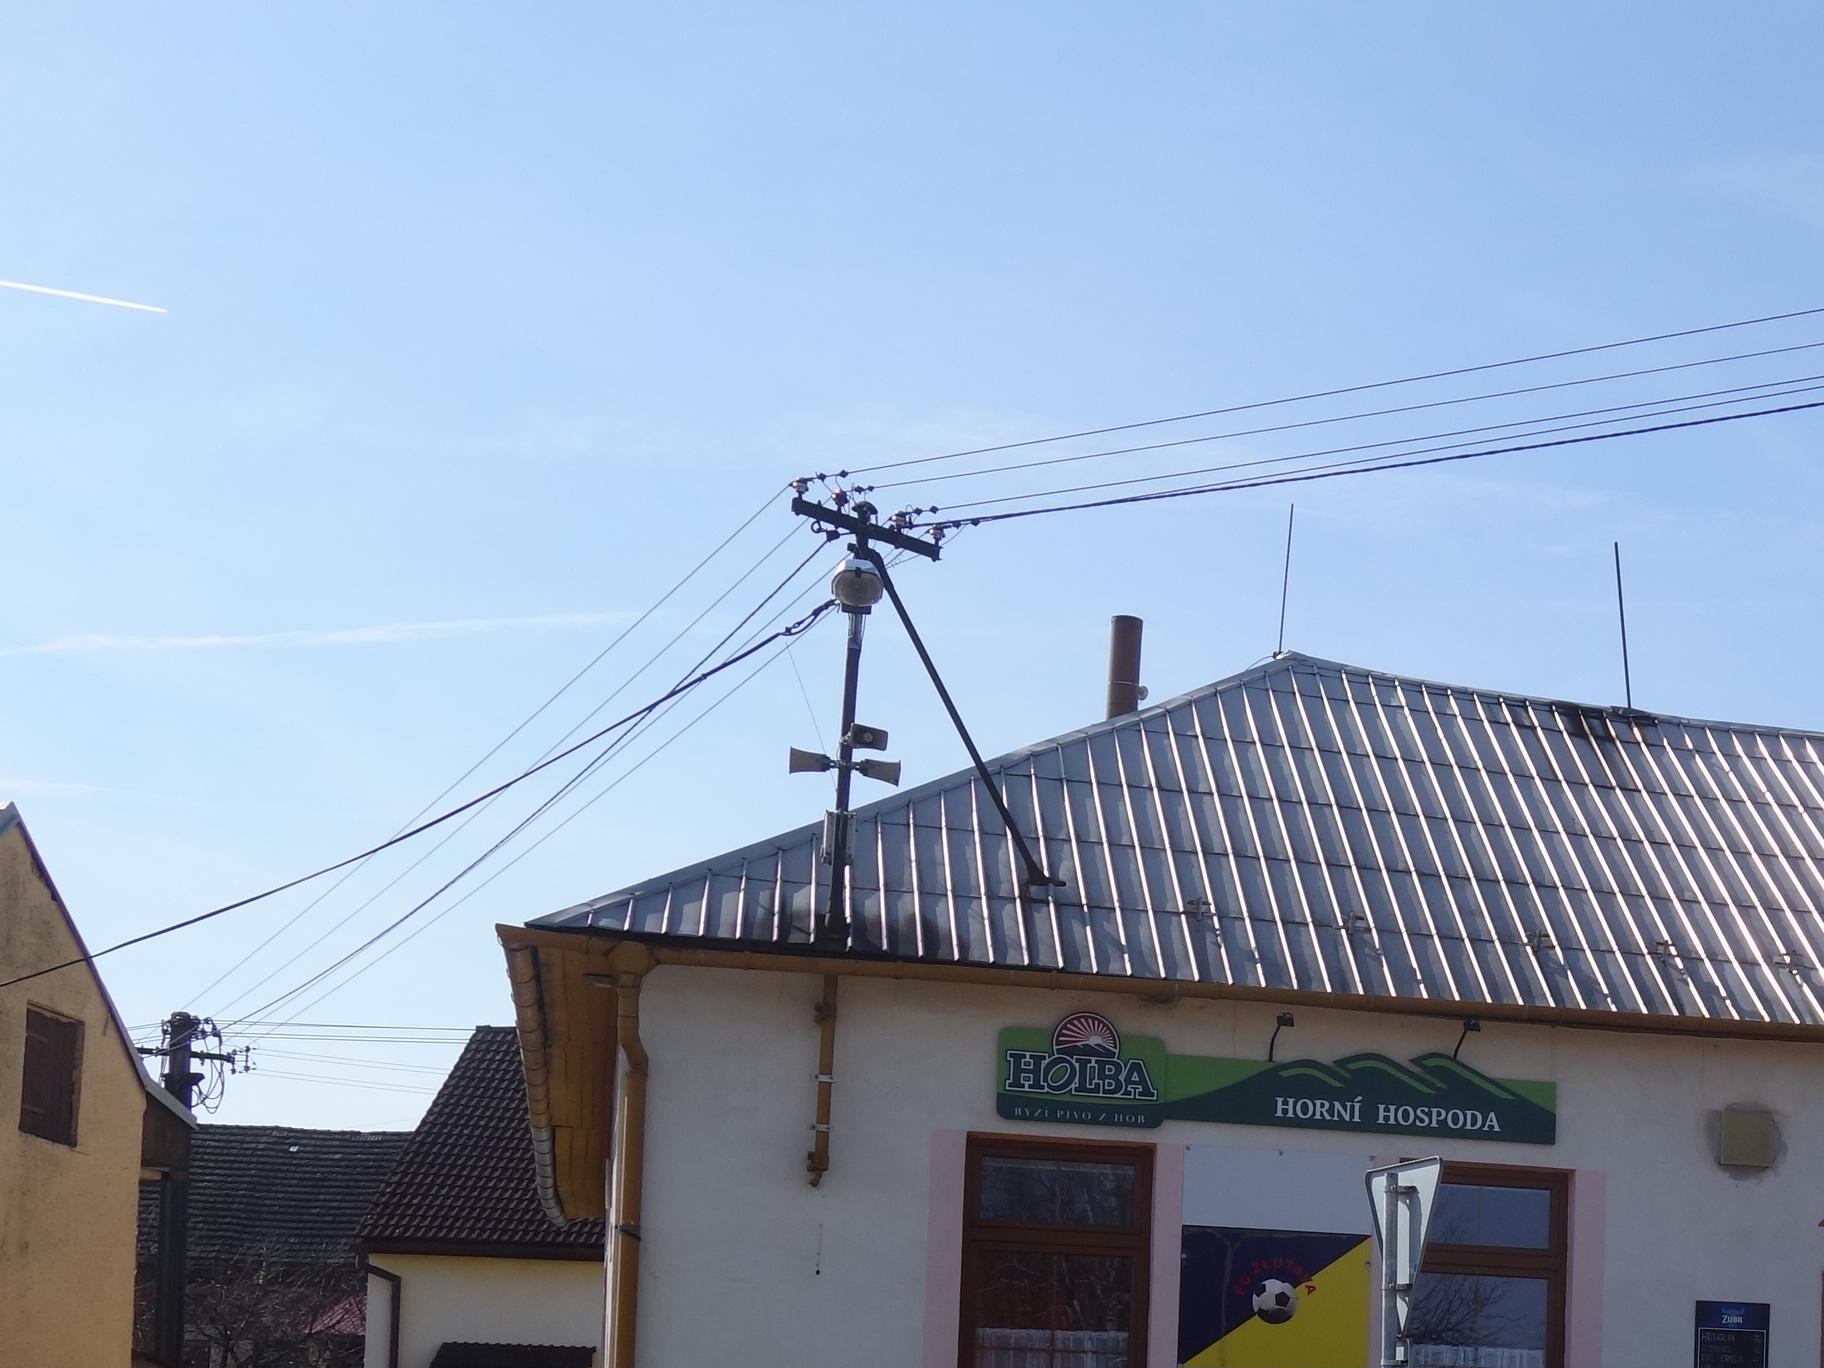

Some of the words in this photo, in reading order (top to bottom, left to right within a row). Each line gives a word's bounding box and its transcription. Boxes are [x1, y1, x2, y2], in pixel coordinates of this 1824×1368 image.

[1005, 1050, 1158, 1101] HOLBA
[1013, 1106, 1049, 1118] RYZÍ
[1057, 1109, 1091, 1120] PIVO
[1098, 1112, 1107, 1121] Z
[1114, 1113, 1145, 1124] HOR
[1275, 1095, 1364, 1122] HORNÍ
[1376, 1104, 1502, 1132] HOSPODA
[1721, 1315, 1743, 1324] ZUBR
